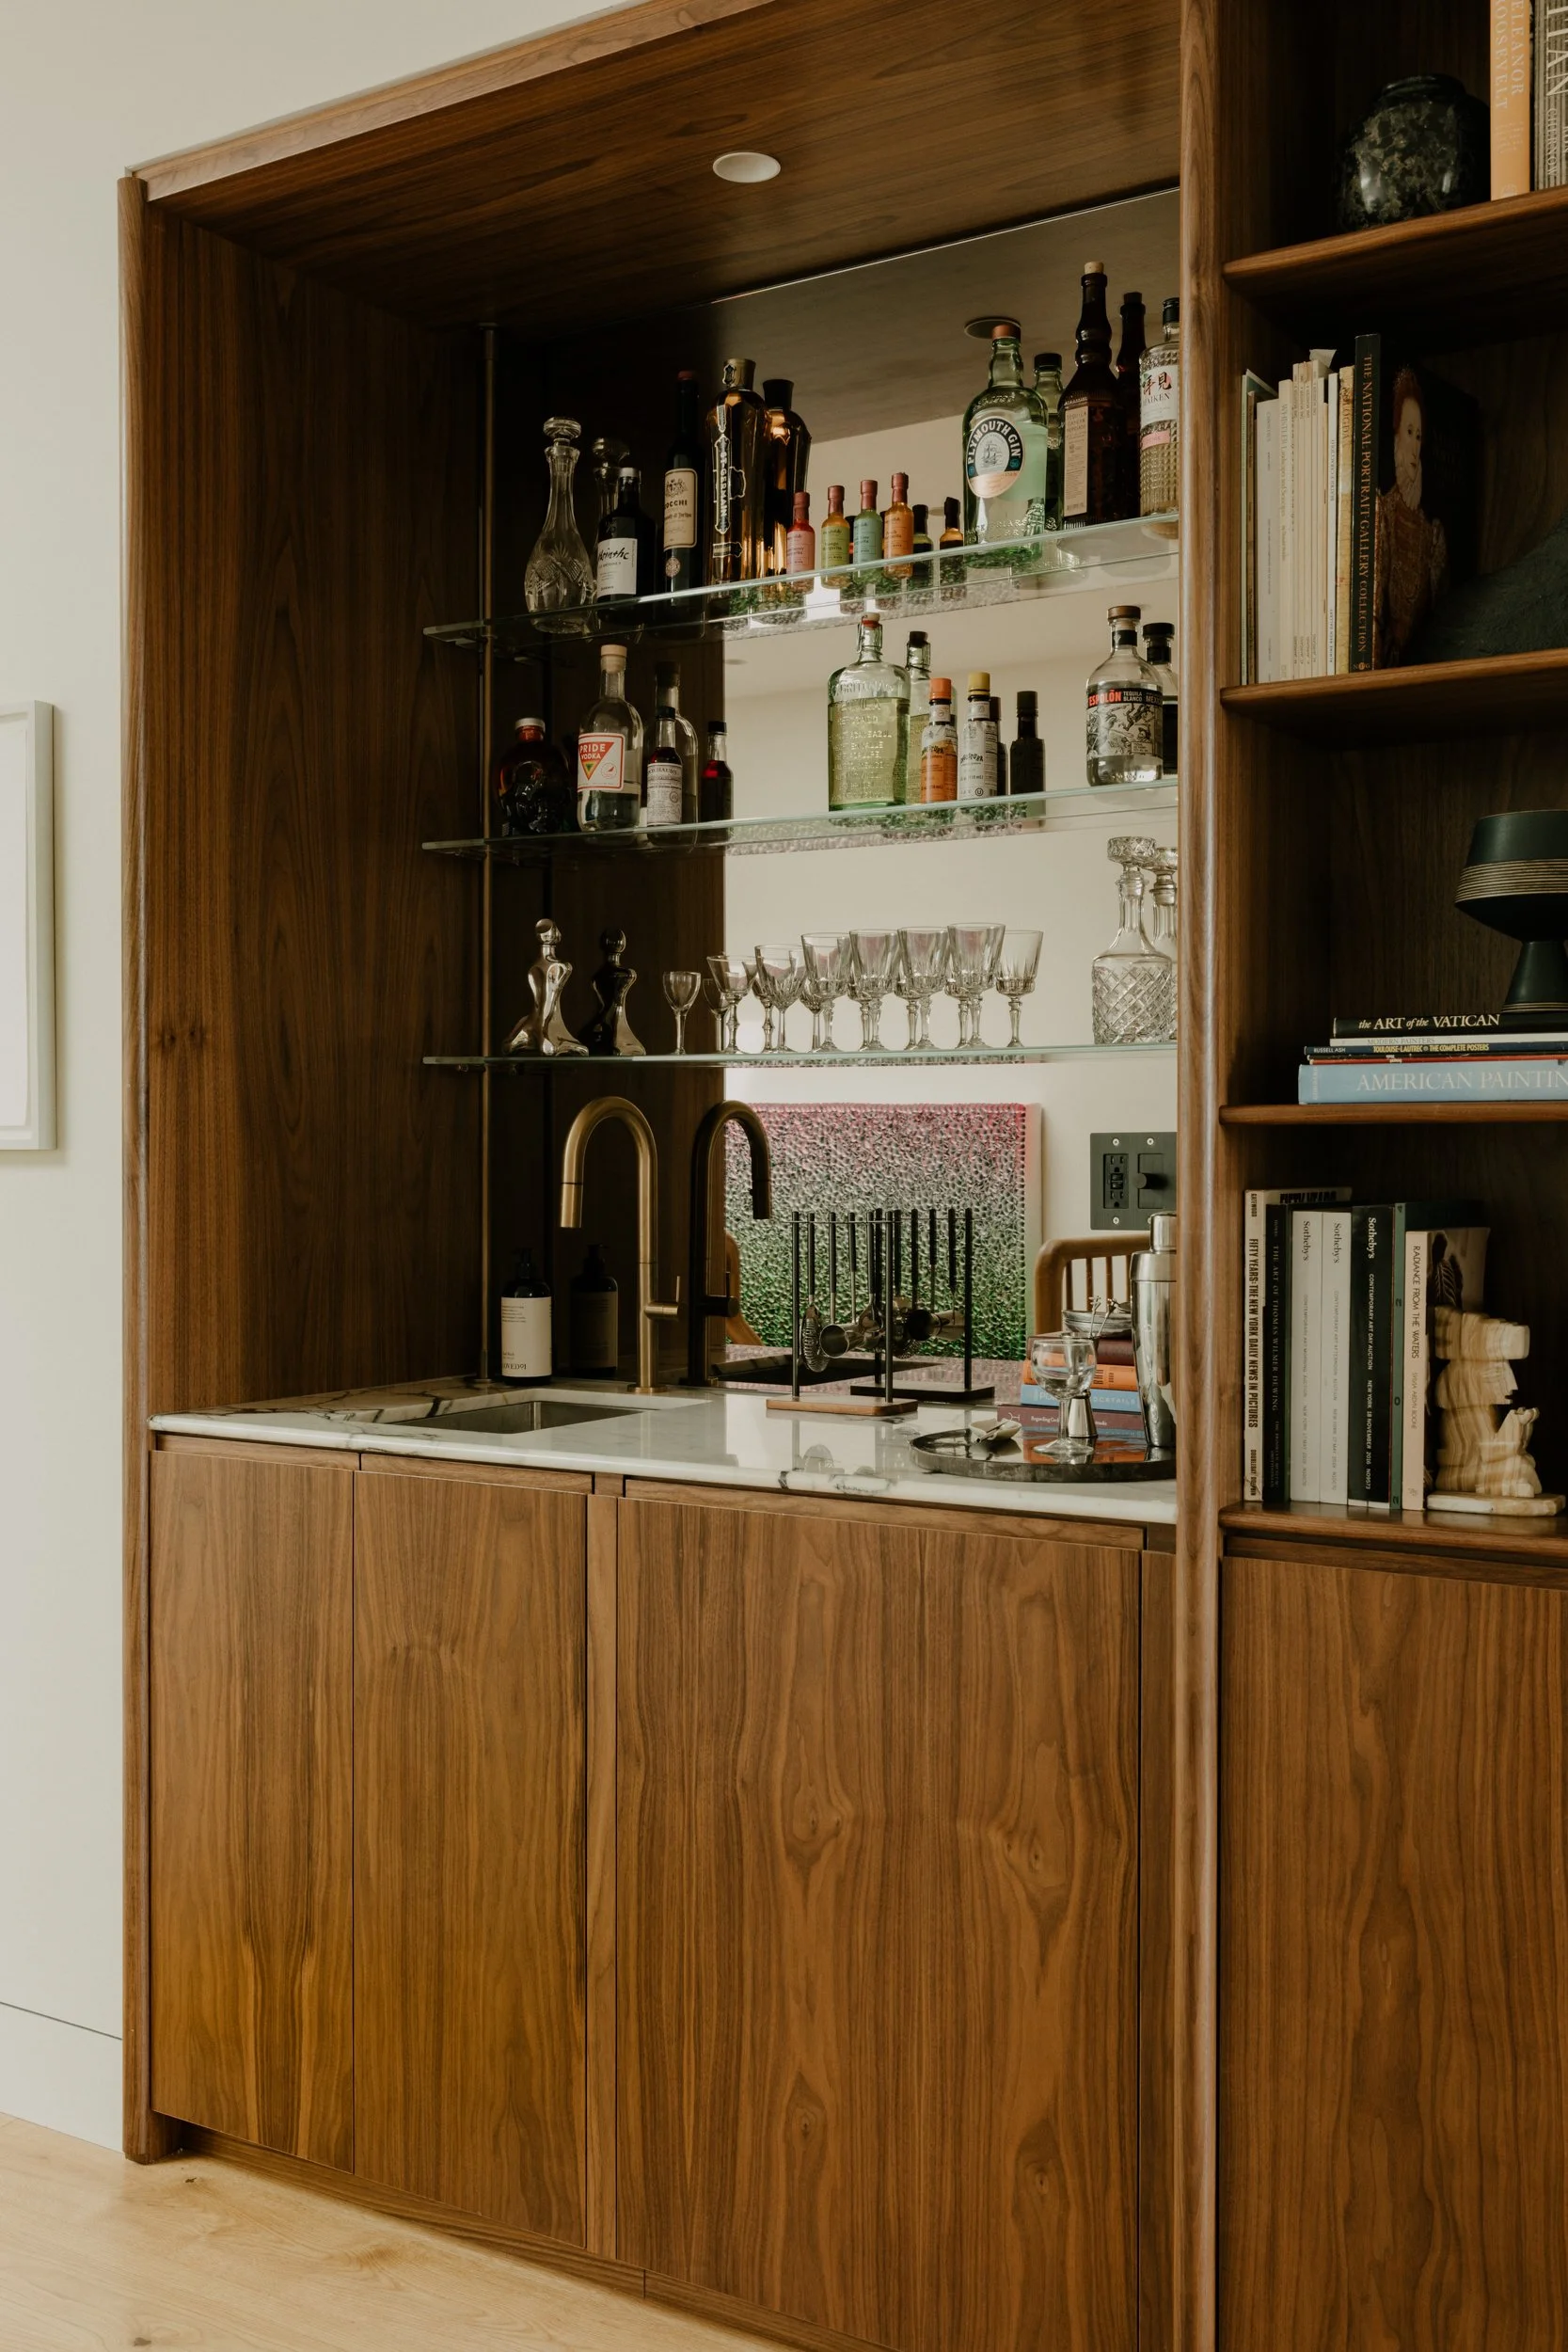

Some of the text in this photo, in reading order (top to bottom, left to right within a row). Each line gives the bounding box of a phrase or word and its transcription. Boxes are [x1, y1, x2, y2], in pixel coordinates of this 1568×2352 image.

[1511, 1, 1524, 96] ELEANOR
[1546, 108, 1559, 177] CHERNOW
[968, 421, 1022, 465] PLYMOUTH GIN
[1357, 354, 1371, 652] THE NATIONAL PORTRAIT GALLERY COLLECTION
[579, 743, 606, 754] PRIDE
[1358, 1014, 1500, 1030] the ART of the VATICAN
[1373, 1044, 1423, 1053] TOULOUSE-LAUTREC
[1466, 1042, 1490, 1051] POSTERS
[1402, 1037, 1435, 1045] PAINTERS
[1356, 1070, 1568, 1091] AMERICAN PAINTIN
[1302, 1220, 1312, 1262] Sotheby's
[1332, 1222, 1342, 1263] Sotheby's
[1367, 1217, 1377, 1259] Sotheby's
[1248, 1239, 1259, 1257] FIFTY
[1248, 1285, 1259, 1298] THE
[1273, 1285, 1279, 1296] OF
[1248, 1299, 1259, 1315] NEW
[1412, 1246, 1421, 1359] RADIANCE FROM THE WATERS
[1248, 1317, 1259, 1336] YORK
[1248, 1339, 1259, 1358] DAILY
[1248, 1359, 1259, 1380] NEWS
[1248, 1382, 1259, 1391] IN
[1093, 1396, 1136, 1405] OCKTAILS
[1248, 1392, 1259, 1428] PICTURES
